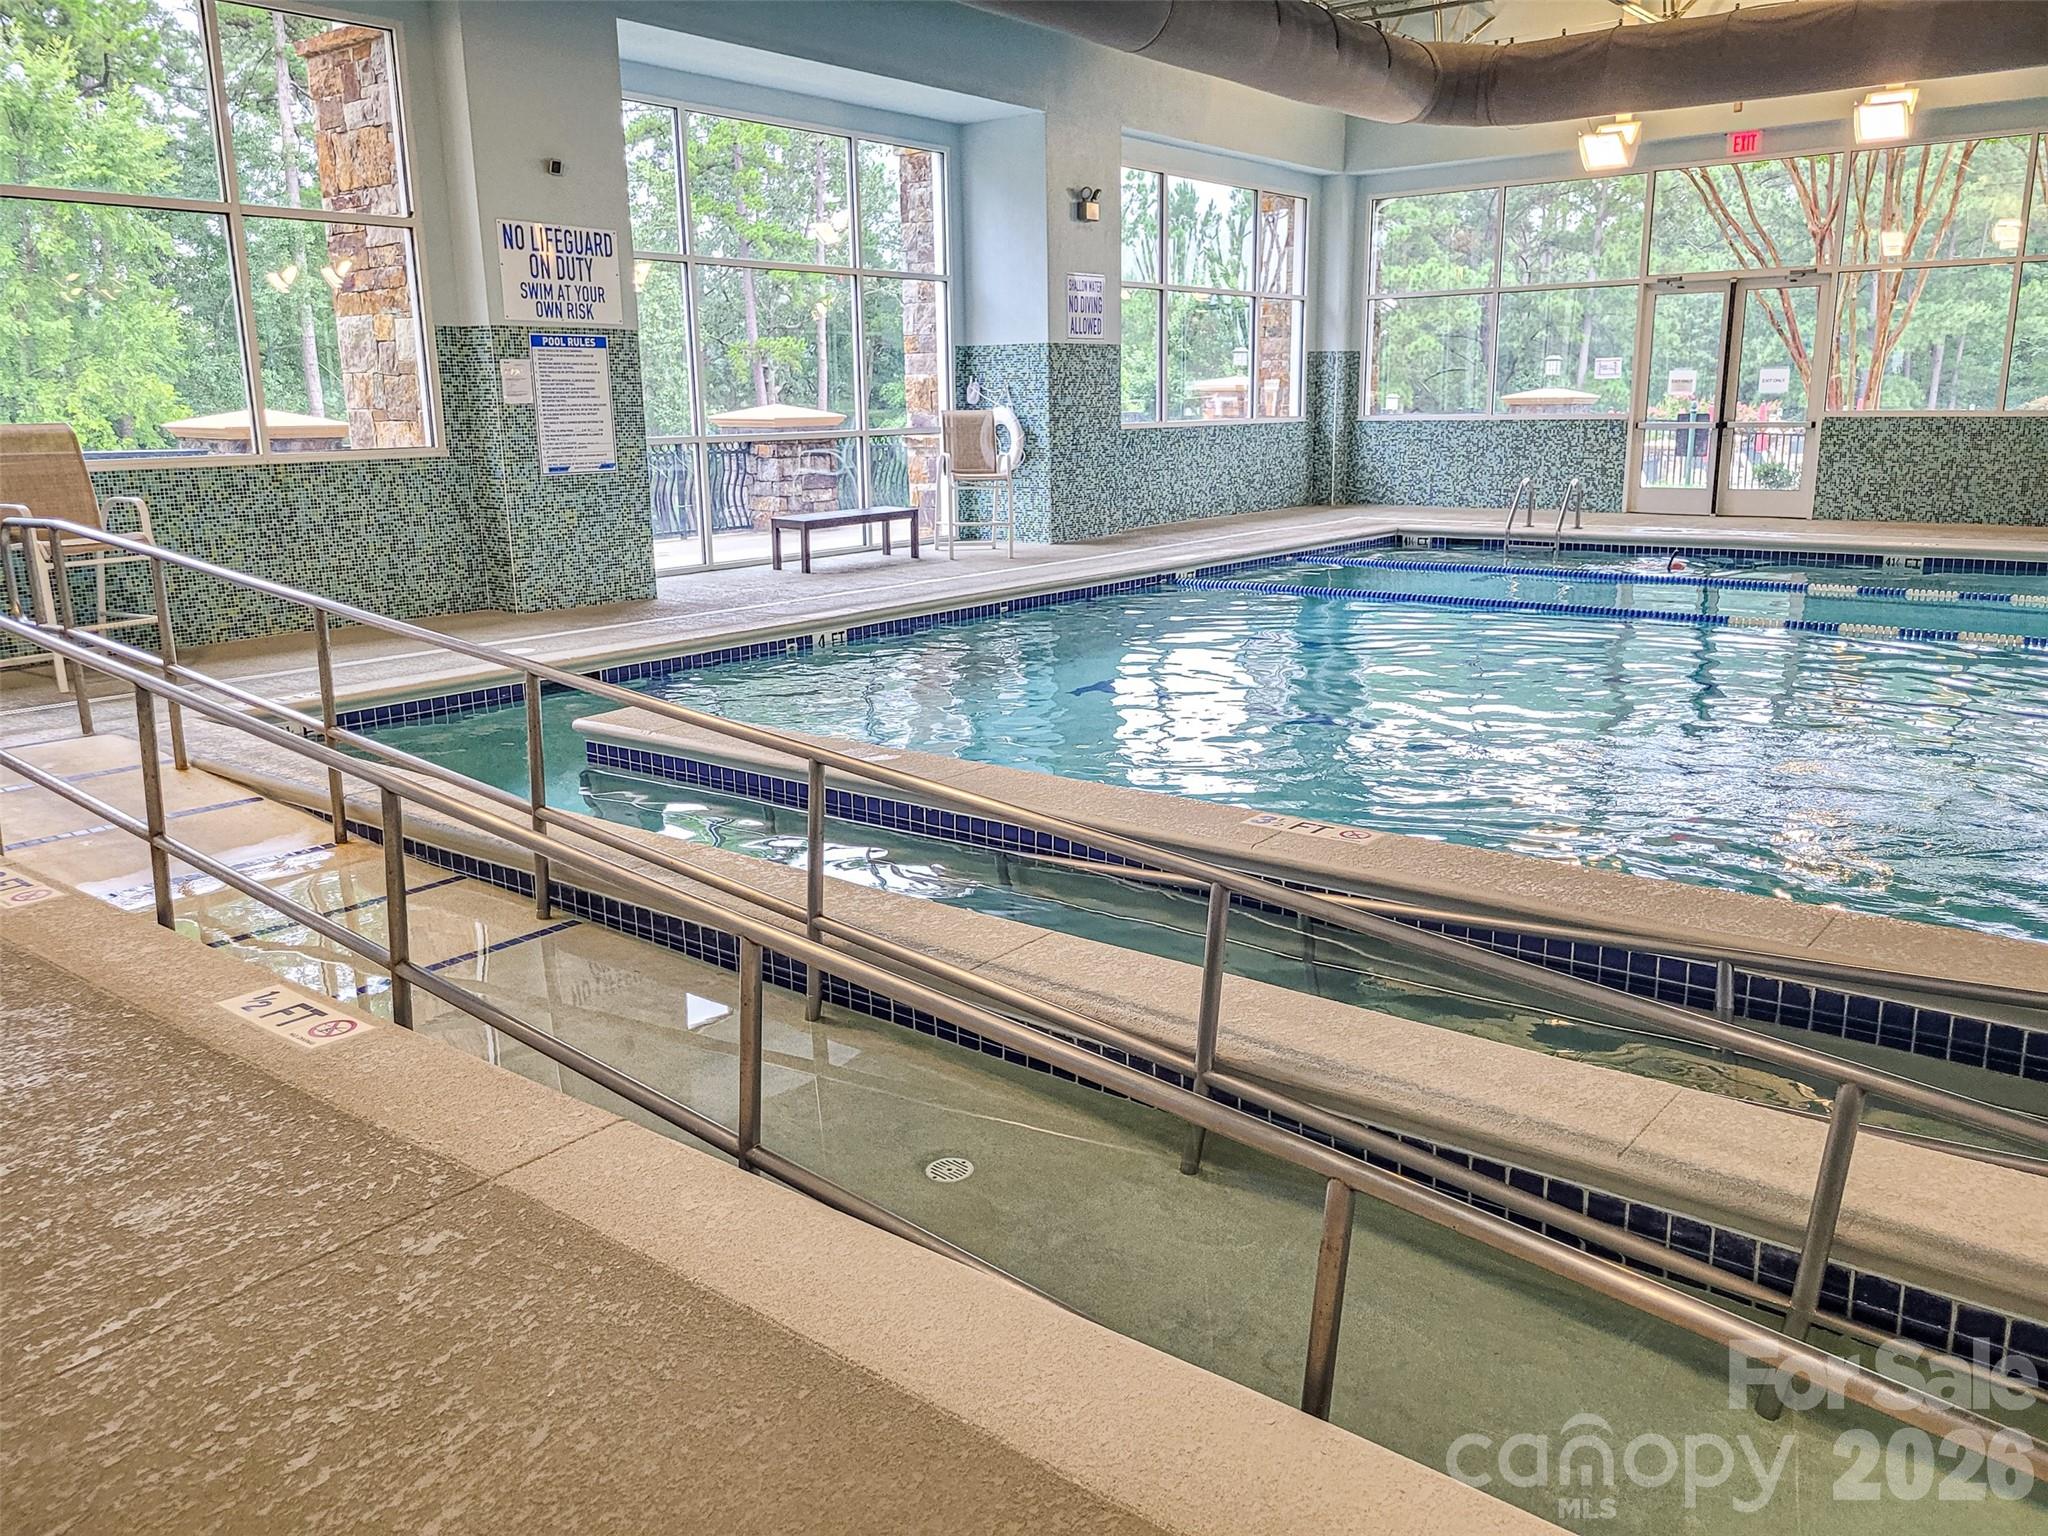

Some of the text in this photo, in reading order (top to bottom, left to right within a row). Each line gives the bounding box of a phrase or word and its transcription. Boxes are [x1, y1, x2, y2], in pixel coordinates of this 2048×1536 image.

[1733, 134, 1757, 152] EXIT
[502, 223, 613, 257] NO LIFEGUARD
[529, 253, 593, 282] ON DUTY
[520, 282, 606, 303] SWIM AT YOUR
[535, 301, 595, 320] OWN RISK
[1068, 295, 1103, 314] NO DIVING
[1070, 317, 1102, 335] ALLOWED
[542, 336, 596, 347] POOL RULES
[1288, 821, 1335, 834] FT
[258, 1002, 329, 1027] FT
